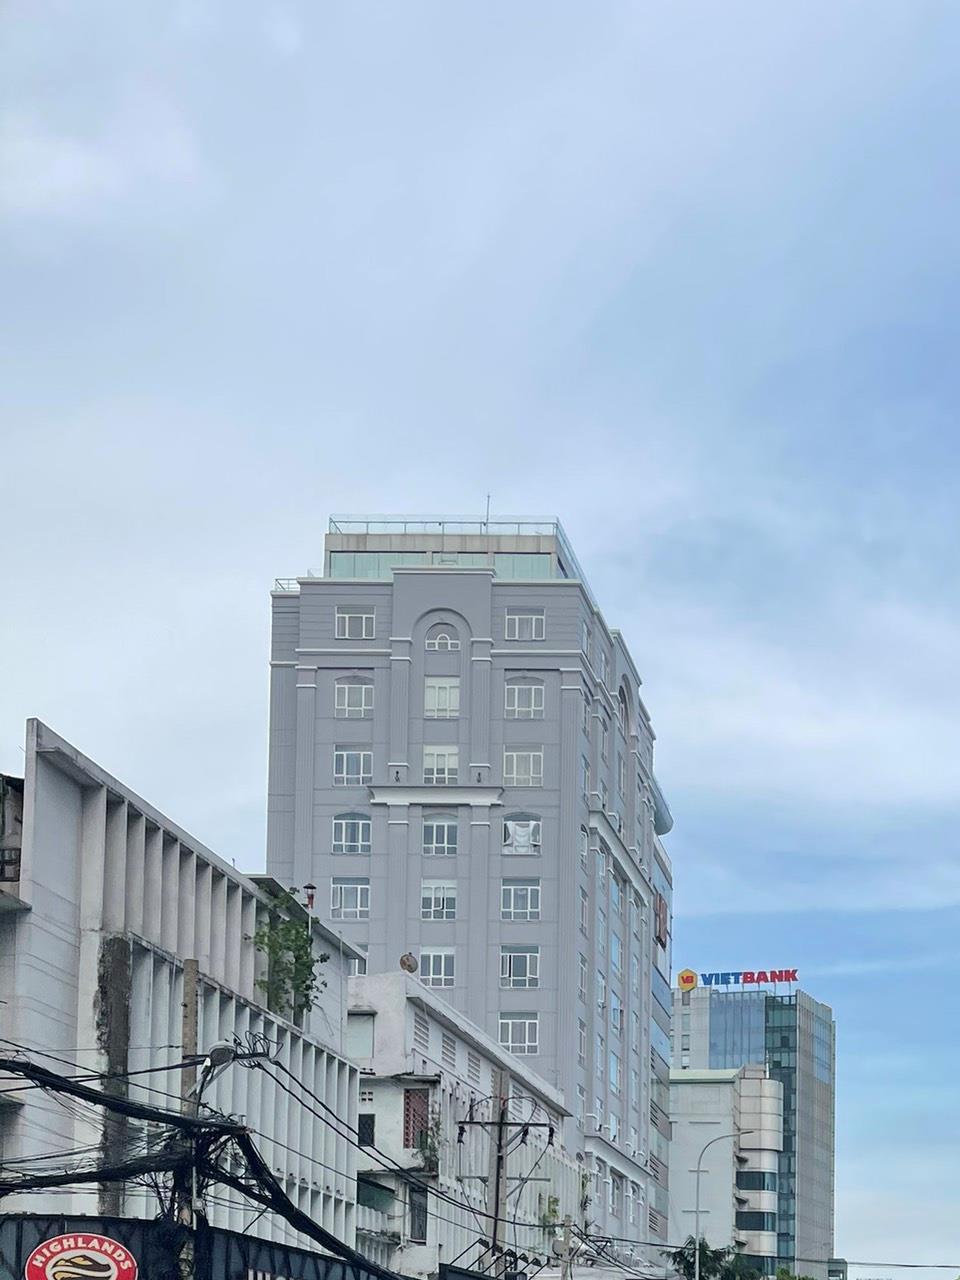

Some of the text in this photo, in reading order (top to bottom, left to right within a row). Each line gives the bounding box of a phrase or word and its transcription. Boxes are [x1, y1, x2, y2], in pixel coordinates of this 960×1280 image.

[681, 975, 694, 984] VB
[701, 969, 799, 986] VIETBANK
[32, 1237, 132, 1270] HIGHLANDS
